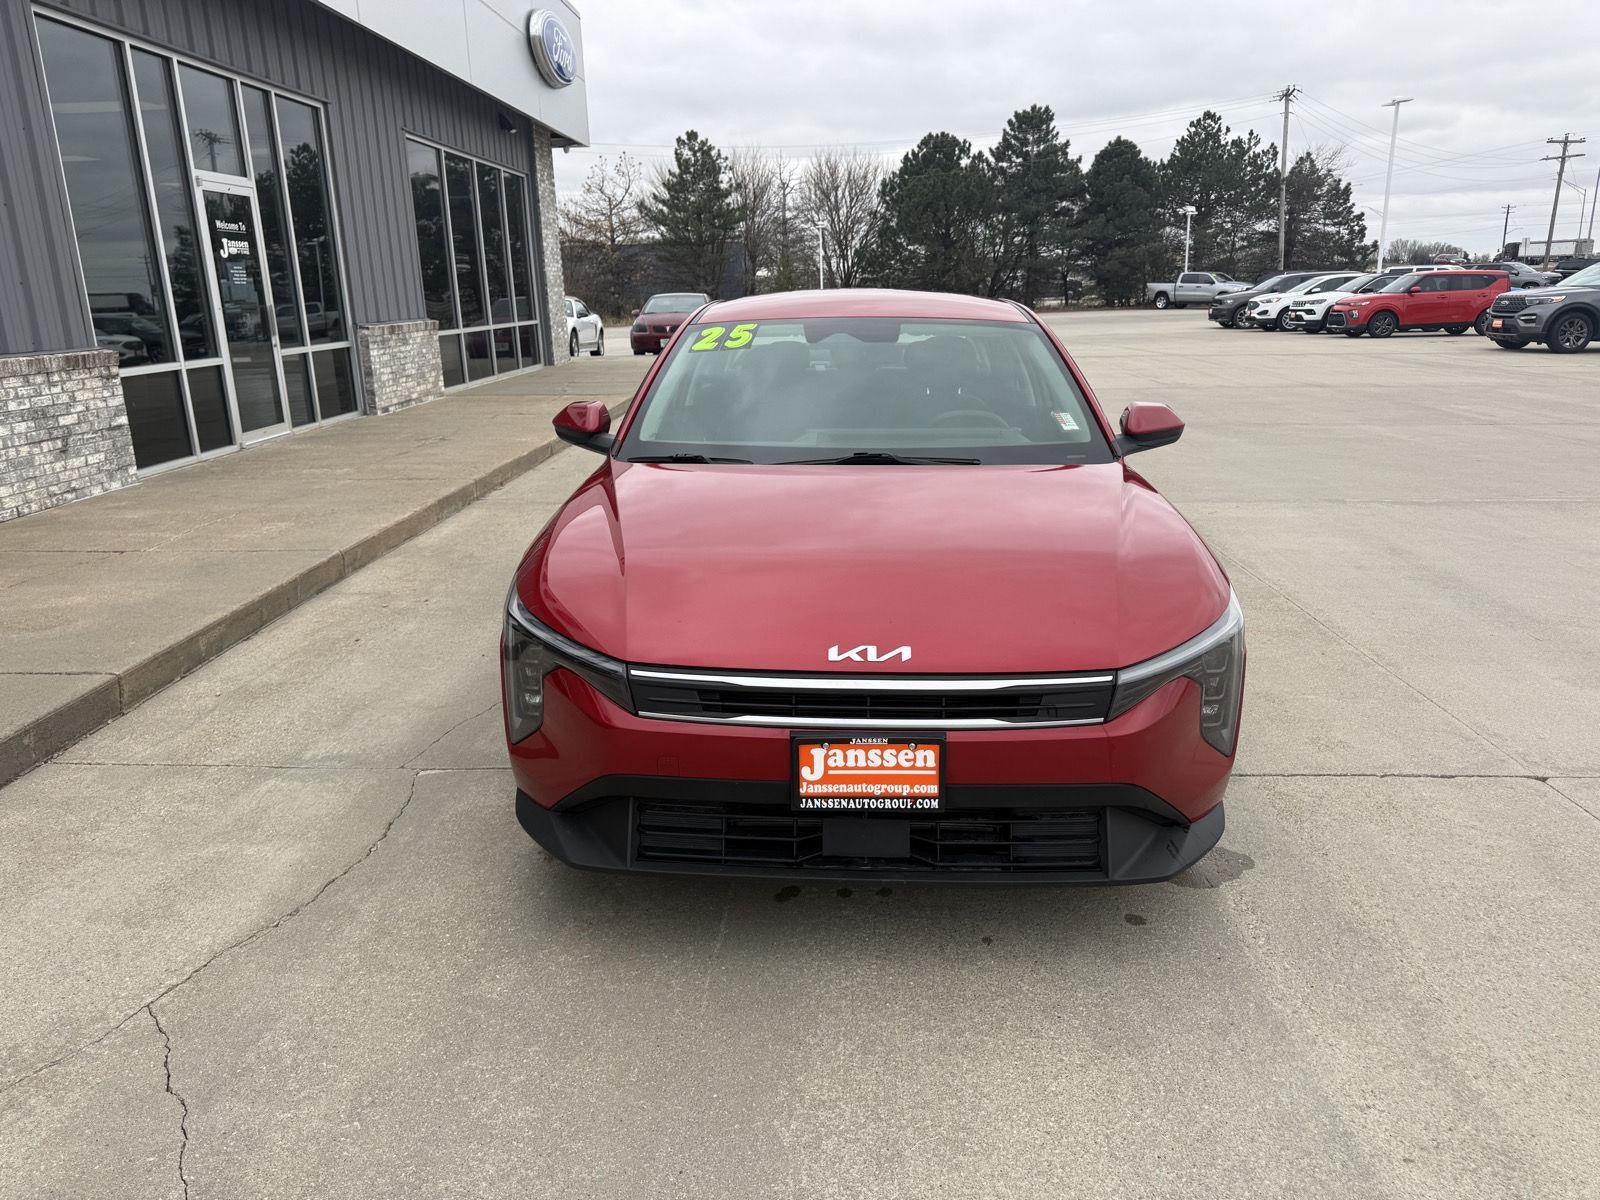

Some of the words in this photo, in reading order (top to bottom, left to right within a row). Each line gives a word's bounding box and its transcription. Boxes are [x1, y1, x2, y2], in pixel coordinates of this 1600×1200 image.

[553, 27, 573, 73] Ford
[215, 219, 239, 231] Welcome
[239, 222, 246, 232] To
[220, 238, 249, 258] Janssen
[691, 323, 758, 351] 25
[828, 645, 911, 662] KIA
[801, 748, 936, 781] Janssen
[800, 782, 938, 795] Janssenautogroup.com
[800, 799, 939, 809] JANSSENAUTOGROUP.COM
